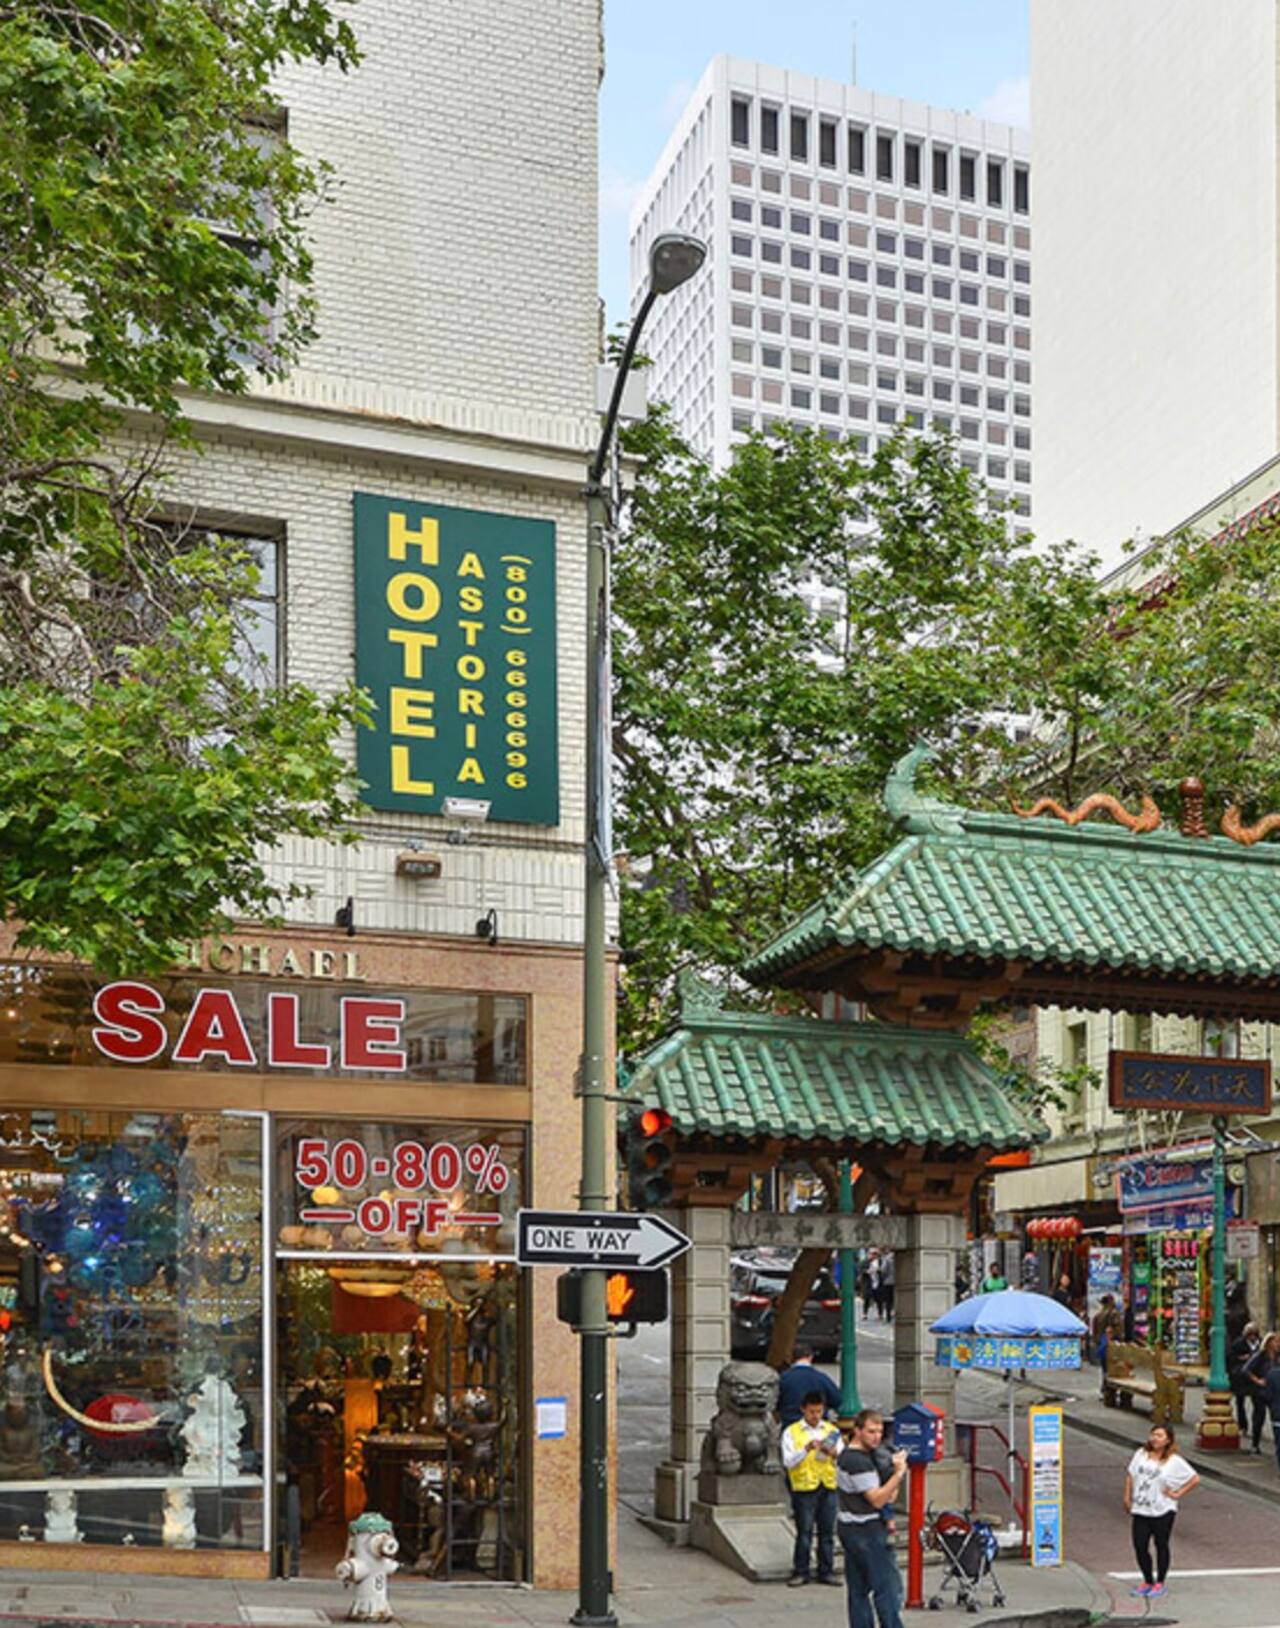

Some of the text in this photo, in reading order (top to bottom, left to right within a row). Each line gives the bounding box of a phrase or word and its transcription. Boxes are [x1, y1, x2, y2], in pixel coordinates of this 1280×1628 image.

[500, 555, 533, 634] (800)
[386, 511, 441, 796] HOTEL
[456, 552, 486, 785] ASTORIA
[184, 938, 367, 983] ICHAEL
[92, 980, 407, 1072] SALE
[296, 1138, 509, 1193] 50-80%
[357, 1198, 451, 1236] OFF
[532, 1229, 632, 1251] ONE WAY
